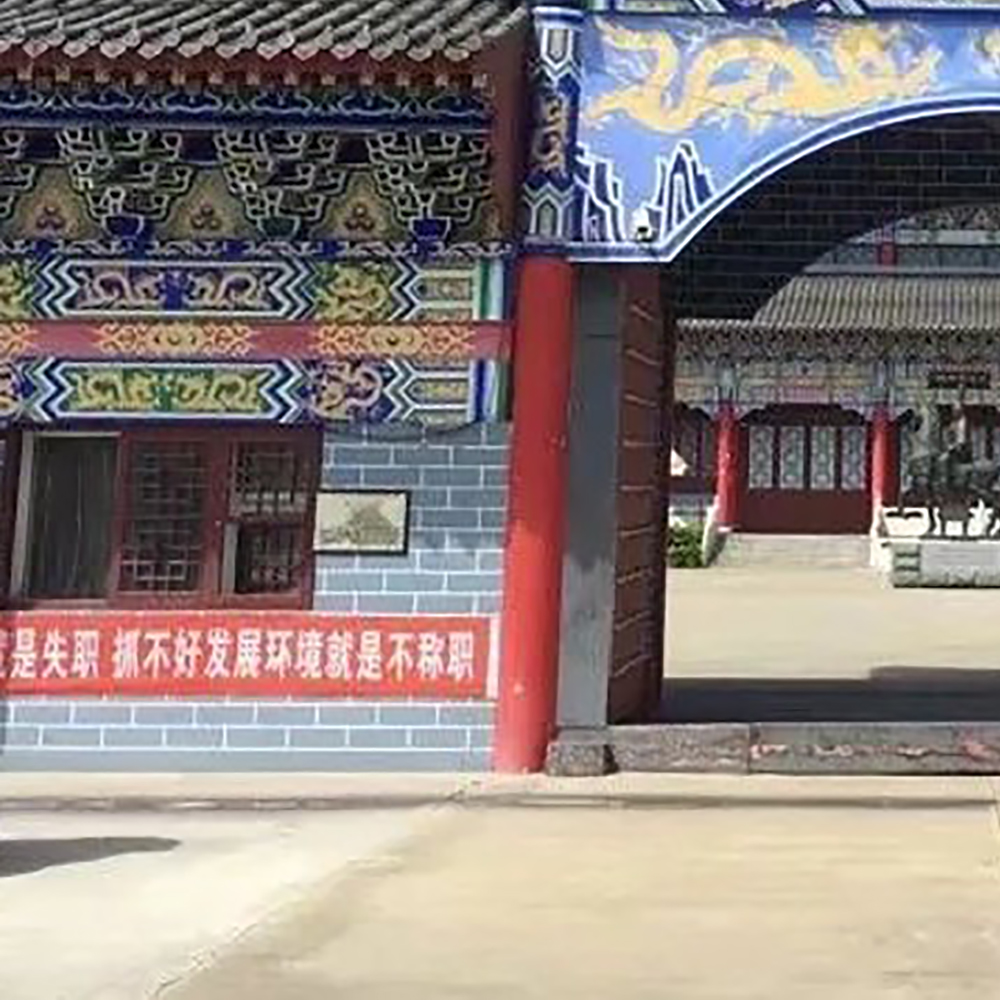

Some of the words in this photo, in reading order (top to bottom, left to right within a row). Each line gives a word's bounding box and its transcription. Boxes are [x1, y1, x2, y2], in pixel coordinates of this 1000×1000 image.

[111, 627, 475, 681] 抓不好发展环境就是不称职
